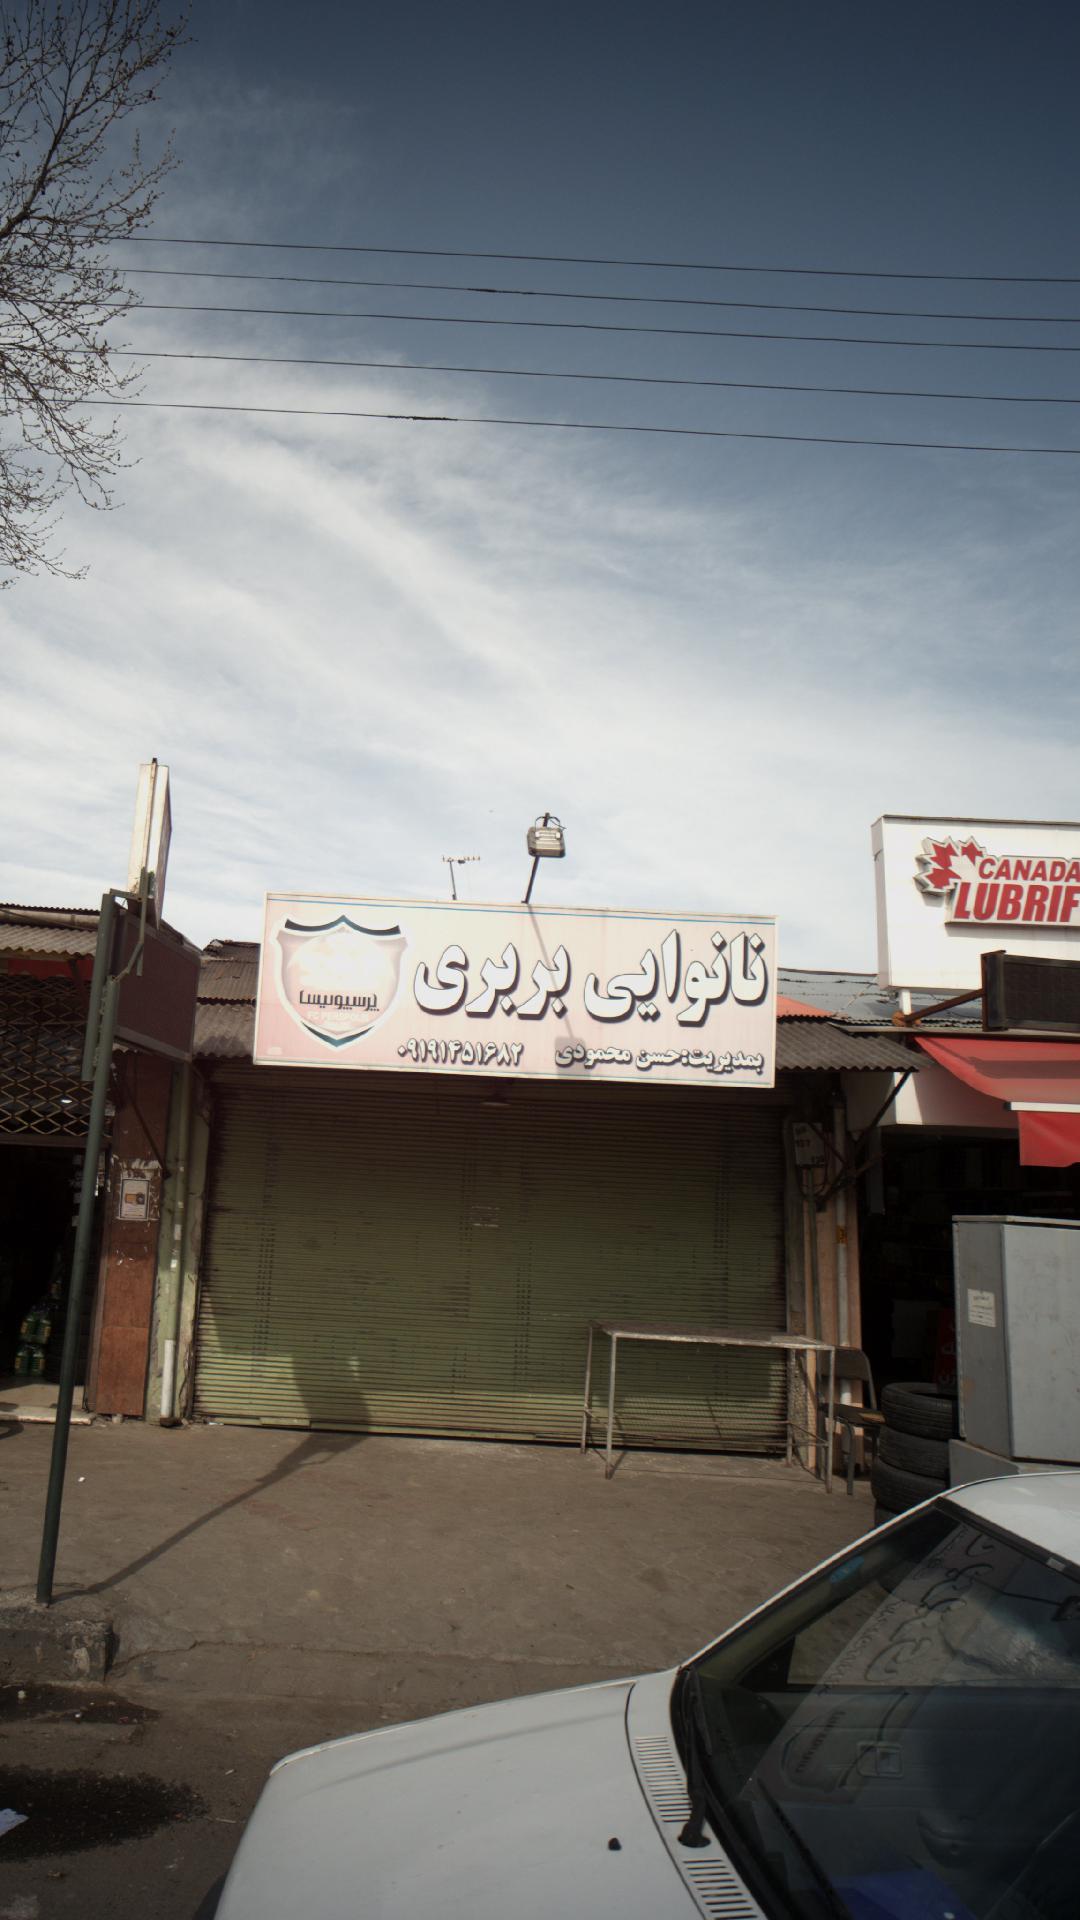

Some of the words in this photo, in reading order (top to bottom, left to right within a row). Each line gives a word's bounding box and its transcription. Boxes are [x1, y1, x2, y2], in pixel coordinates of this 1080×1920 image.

[978, 858, 1080, 883] CANADA
[413, 942, 572, 1021] بربری
[584, 928, 769, 1028] نانوایی
[397, 1037, 524, 1067] ۰۹۱۹۱۴۵۱۶۸۲
[555, 1043, 633, 1070] محمودی
